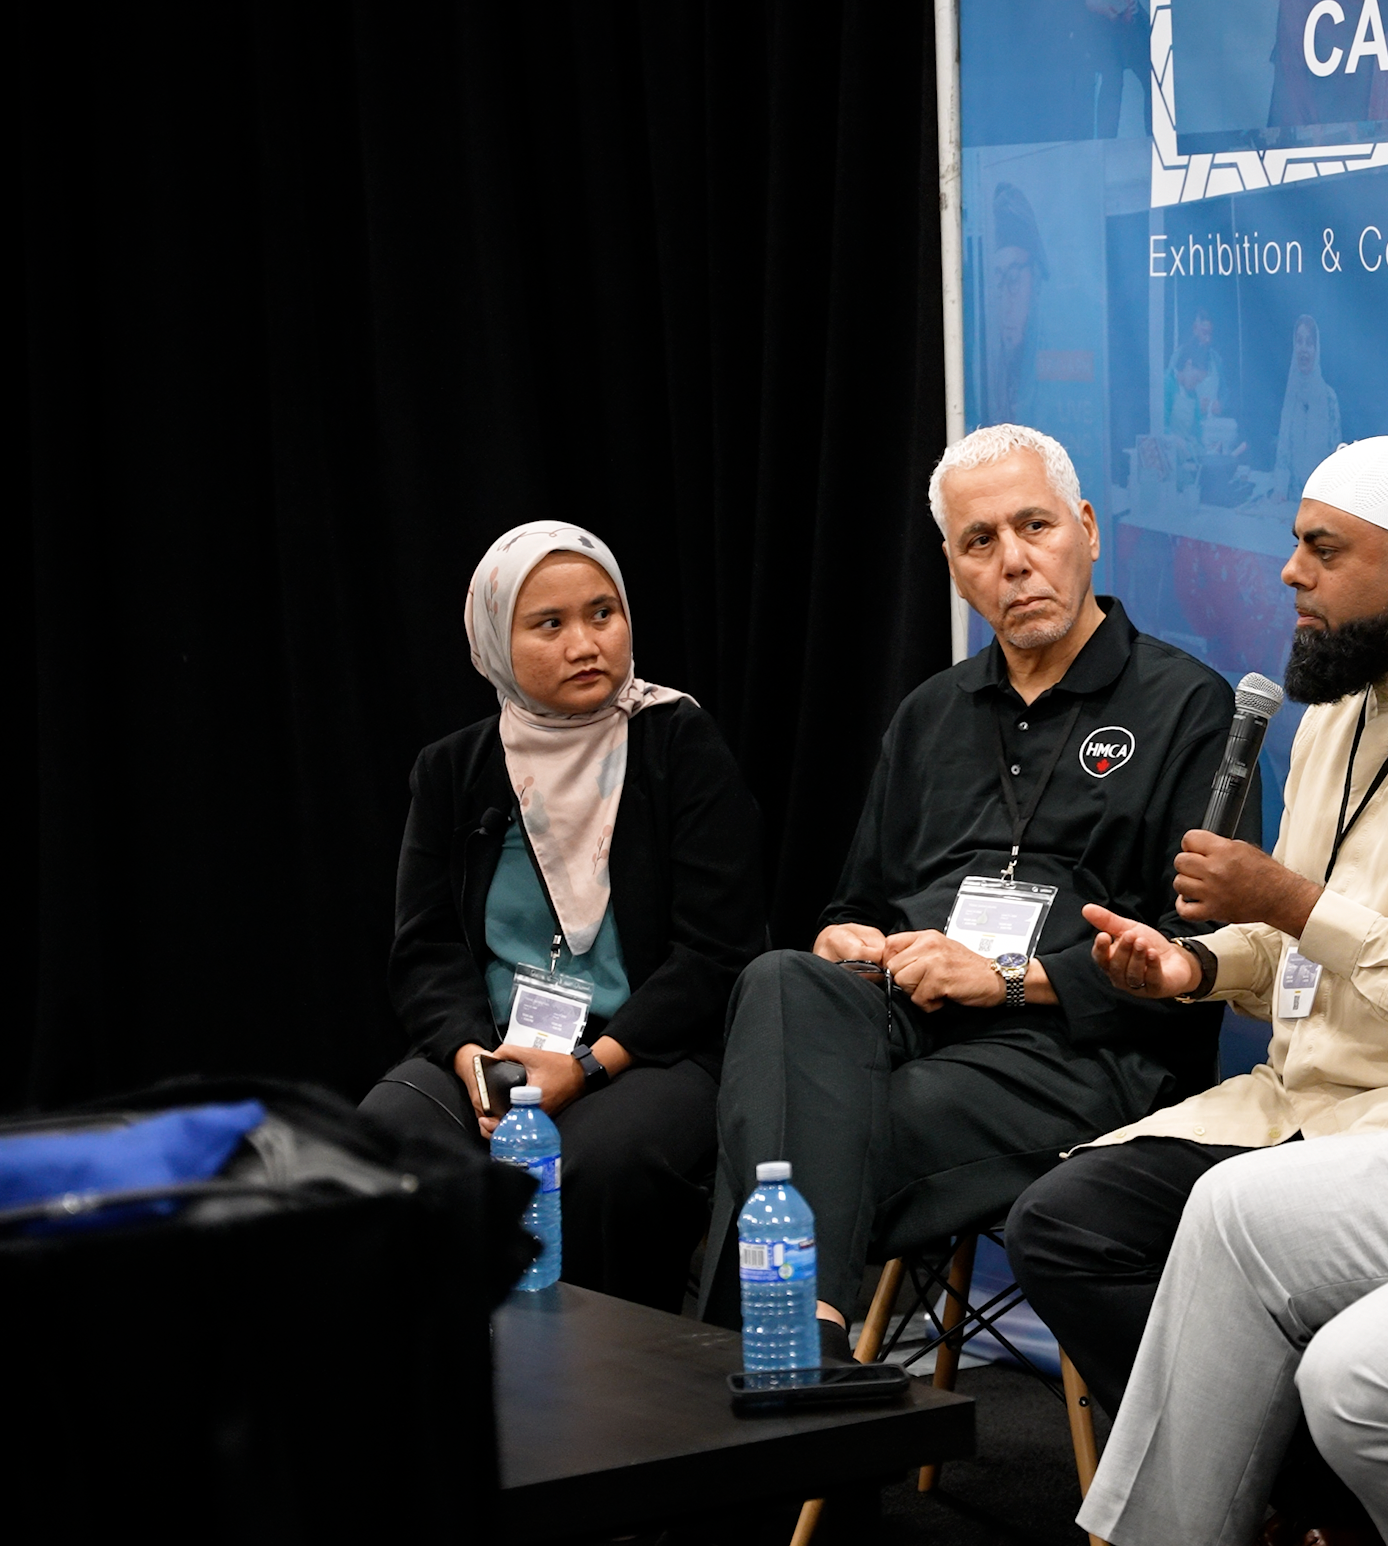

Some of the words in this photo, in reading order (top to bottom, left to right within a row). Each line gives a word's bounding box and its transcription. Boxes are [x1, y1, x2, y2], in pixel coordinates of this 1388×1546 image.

[1149, 231, 1302, 278] Exhibition
[1321, 227, 1342, 273] &
[1086, 742, 1128, 758] HMCA
